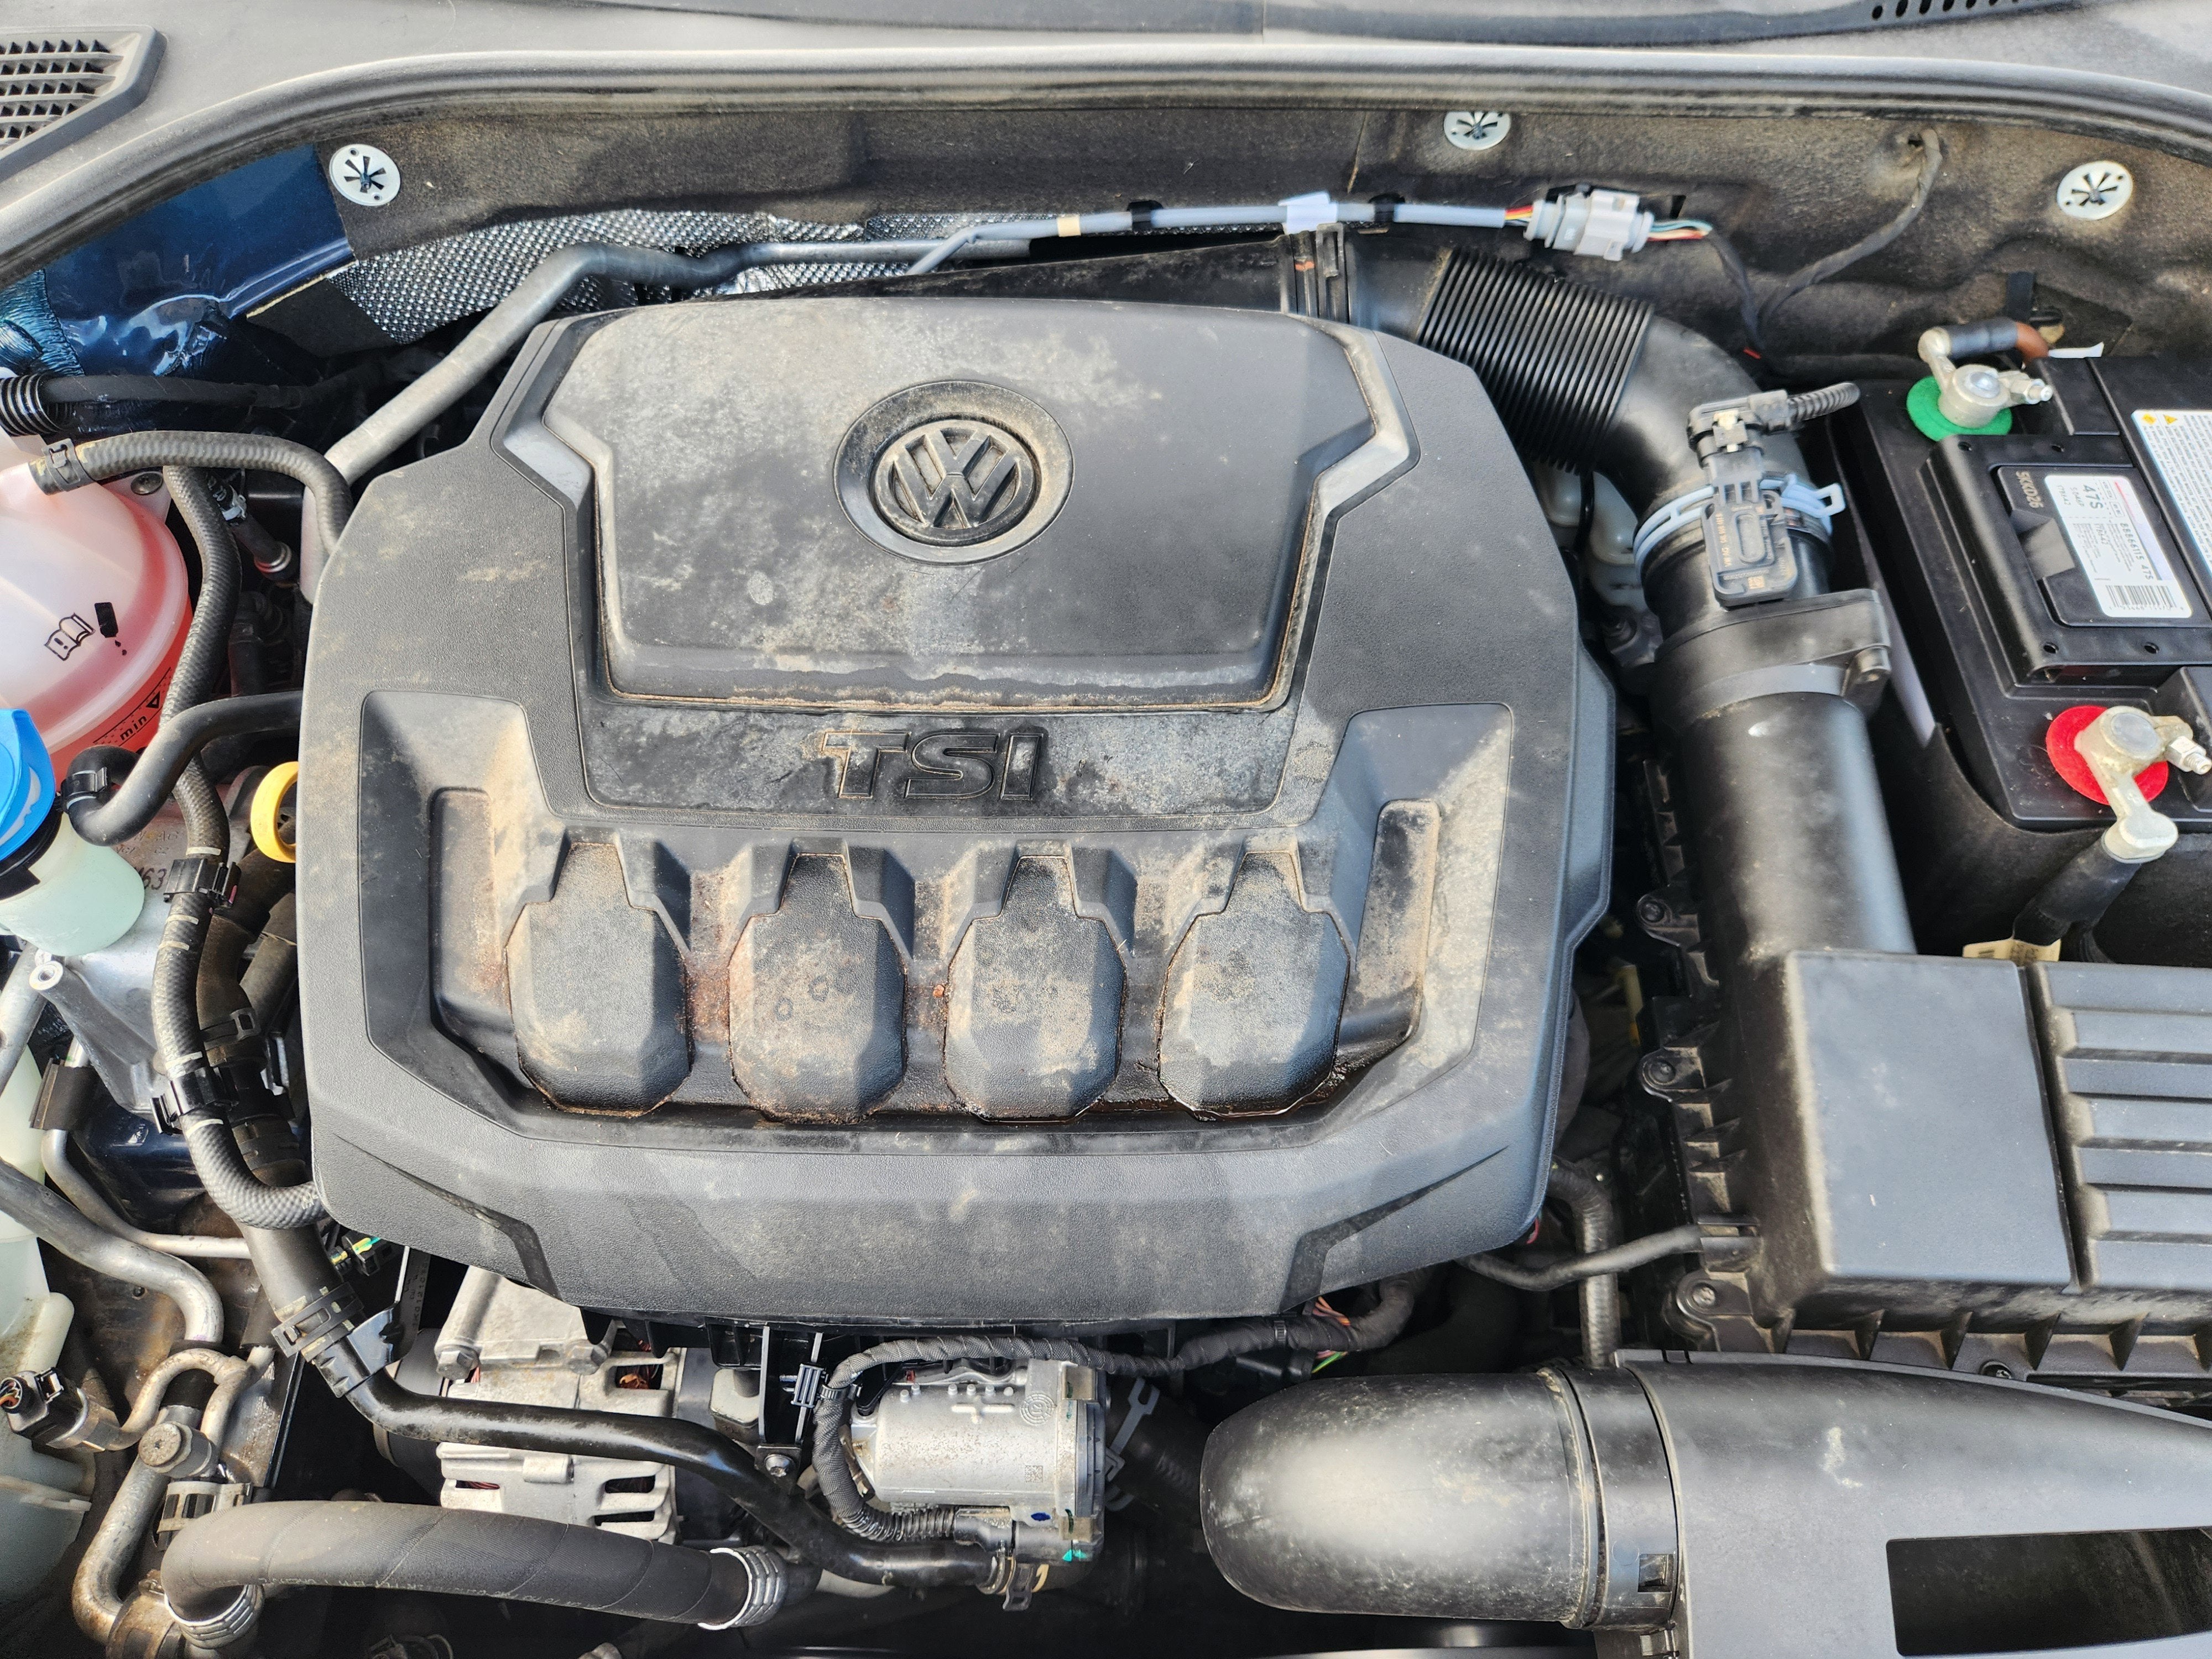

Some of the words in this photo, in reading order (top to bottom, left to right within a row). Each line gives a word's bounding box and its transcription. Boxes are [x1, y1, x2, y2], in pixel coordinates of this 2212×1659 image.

[885, 424, 1024, 536] VW
[2083, 484, 2104, 509] 47S
[119, 714, 148, 741] min
[821, 730, 1045, 800] TSI
